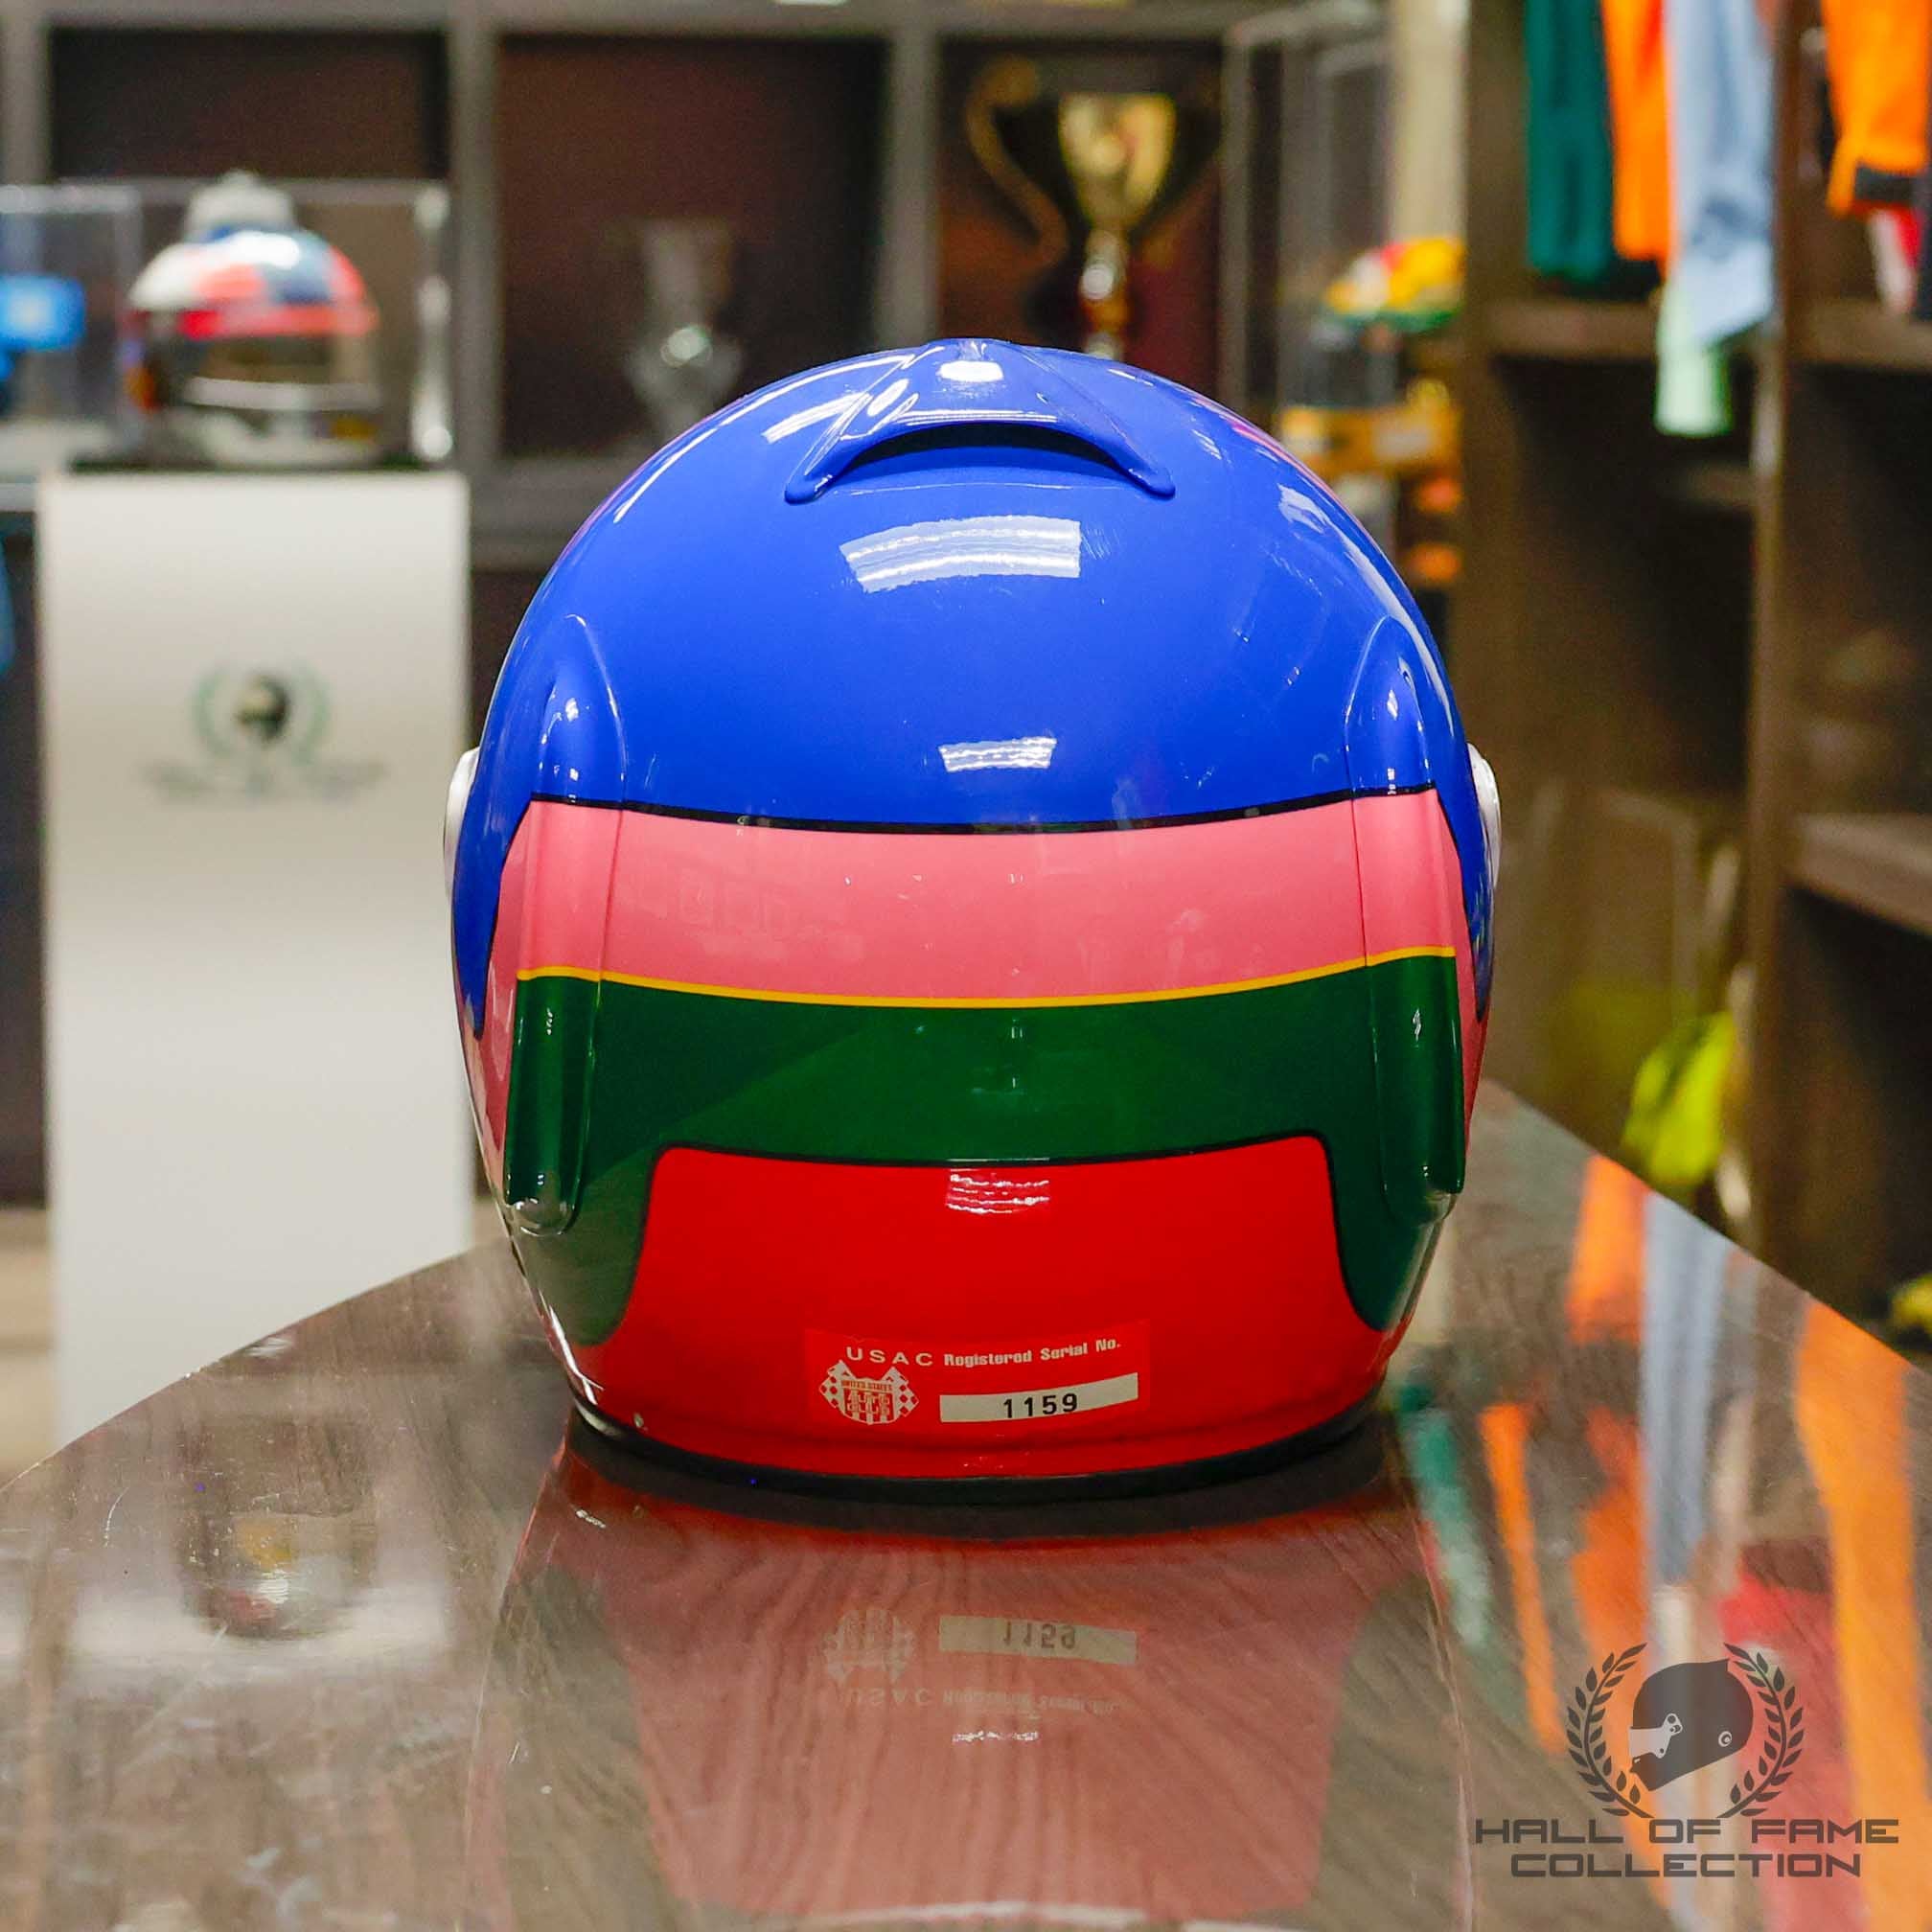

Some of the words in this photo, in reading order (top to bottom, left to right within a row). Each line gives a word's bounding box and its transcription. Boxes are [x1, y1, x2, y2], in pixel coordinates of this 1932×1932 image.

[846, 1346, 933, 1367] USAC
[944, 1349, 1032, 1368] Registered
[1041, 1342, 1088, 1361] Serial
[1095, 1338, 1121, 1350] No.
[1003, 1393, 1077, 1418] 1159
